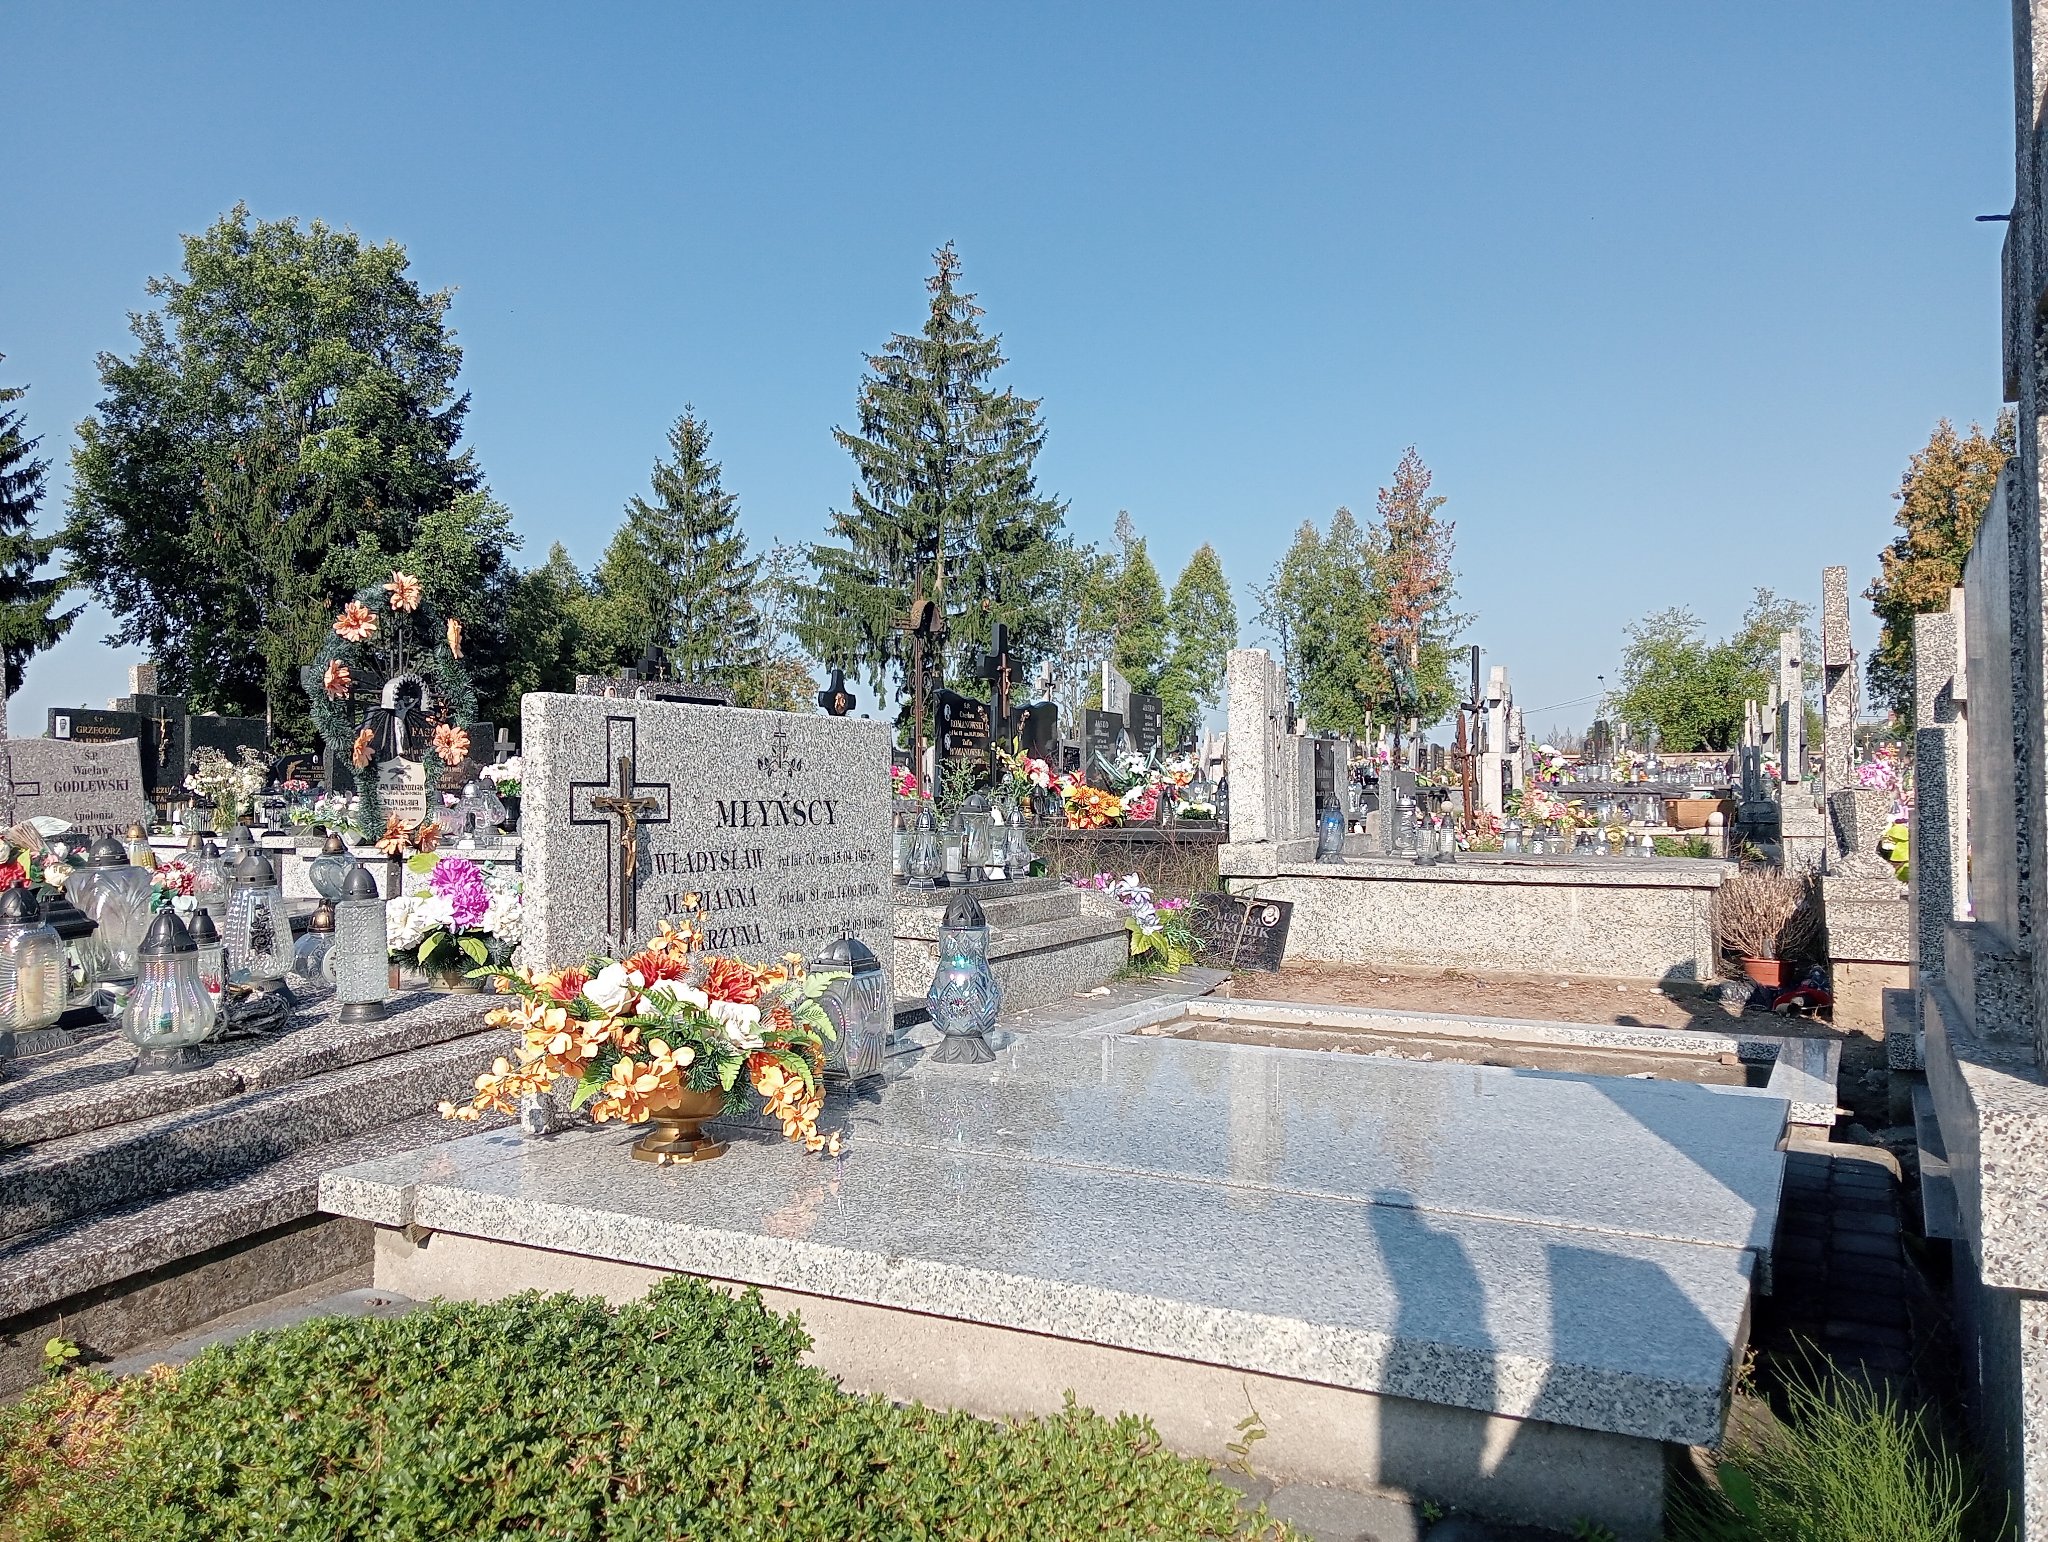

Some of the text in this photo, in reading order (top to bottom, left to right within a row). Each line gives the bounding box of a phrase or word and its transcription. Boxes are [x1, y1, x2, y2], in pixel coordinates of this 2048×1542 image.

[75, 726, 121, 735] GRZEGORZ
[72, 765, 110, 776] Wacław
[54, 779, 129, 793] GODLEWSKI
[150, 795, 167, 803] UFA
[715, 790, 839, 828] MŁYŃSCY
[74, 810, 114, 823] Apolonia
[654, 848, 765, 875] WŁADYSŁAW
[1203, 918, 1270, 939] JAKUBIK
